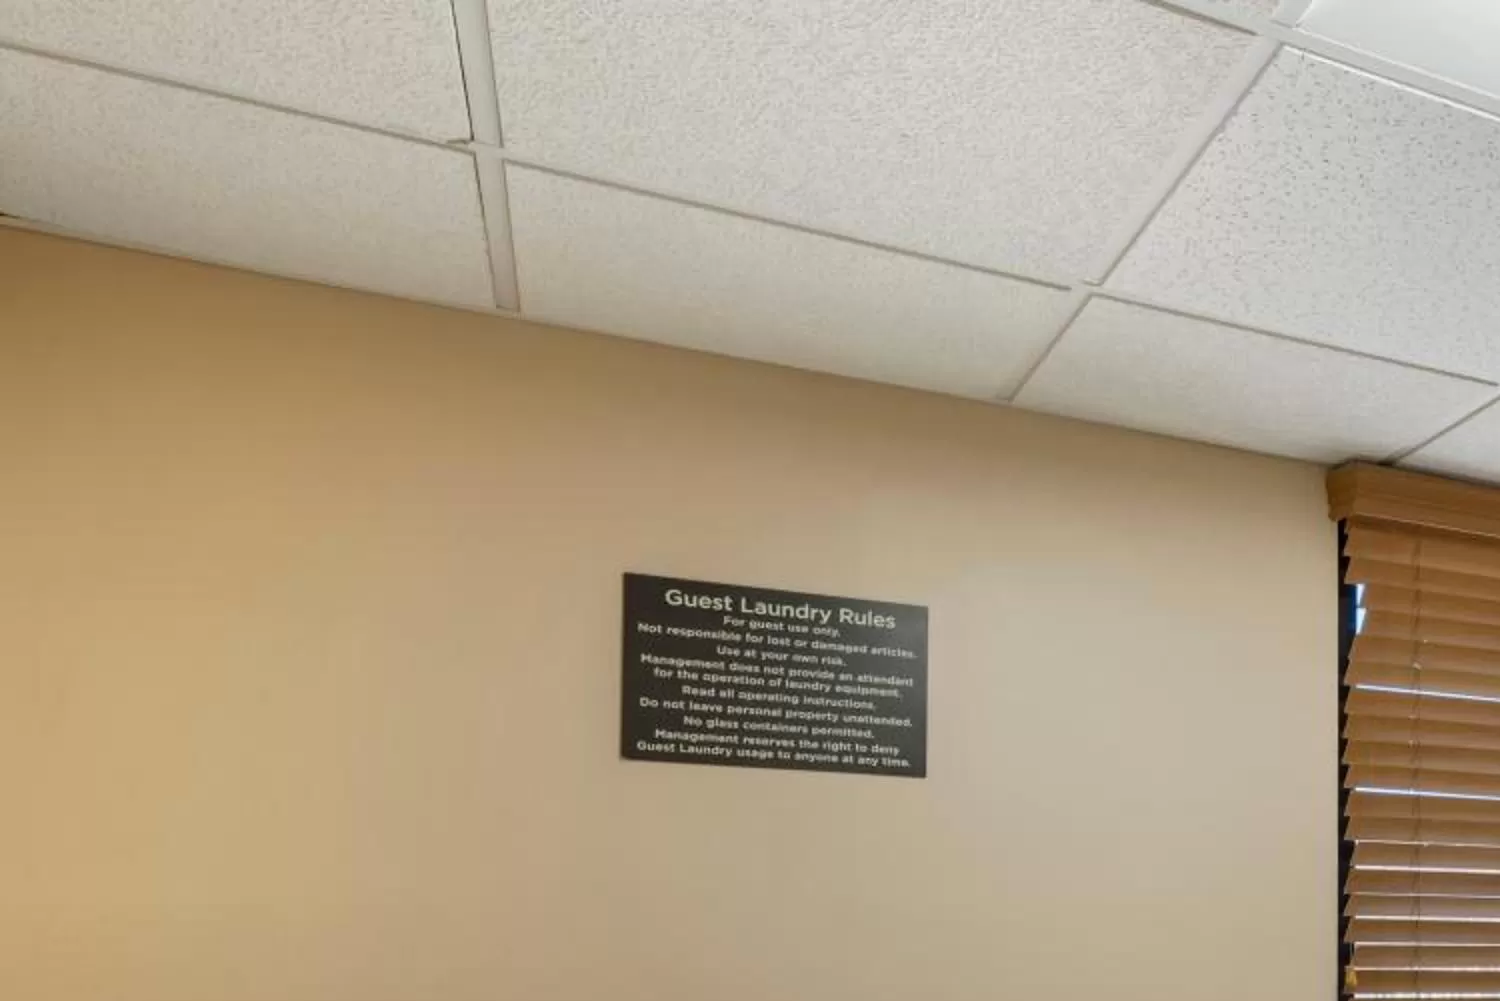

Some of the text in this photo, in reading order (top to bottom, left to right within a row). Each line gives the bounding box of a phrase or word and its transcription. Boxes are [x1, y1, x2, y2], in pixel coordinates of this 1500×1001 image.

[665, 589, 896, 629] Guest Laundry Rules
[637, 622, 918, 658] Not responsible for lost or damaged articles.
[724, 615, 840, 638] For guest use only.
[716, 644, 847, 666] Use at your own risk.
[640, 653, 913, 687] Management does not provide an attendant
[654, 667, 673, 678] for
[677, 669, 699, 680] the
[702, 673, 764, 686] operation
[768, 677, 782, 688] of
[785, 679, 831, 692] laundry
[682, 685, 876, 709] Read all operating instructions.
[640, 696, 912, 727] Do not leave personal property unattended.
[683, 715, 874, 738] No glass containers permitted.
[637, 740, 911, 767] Guest Laundry usage to anyone at any time.
[655, 729, 900, 757] Management reserves the right to deny
